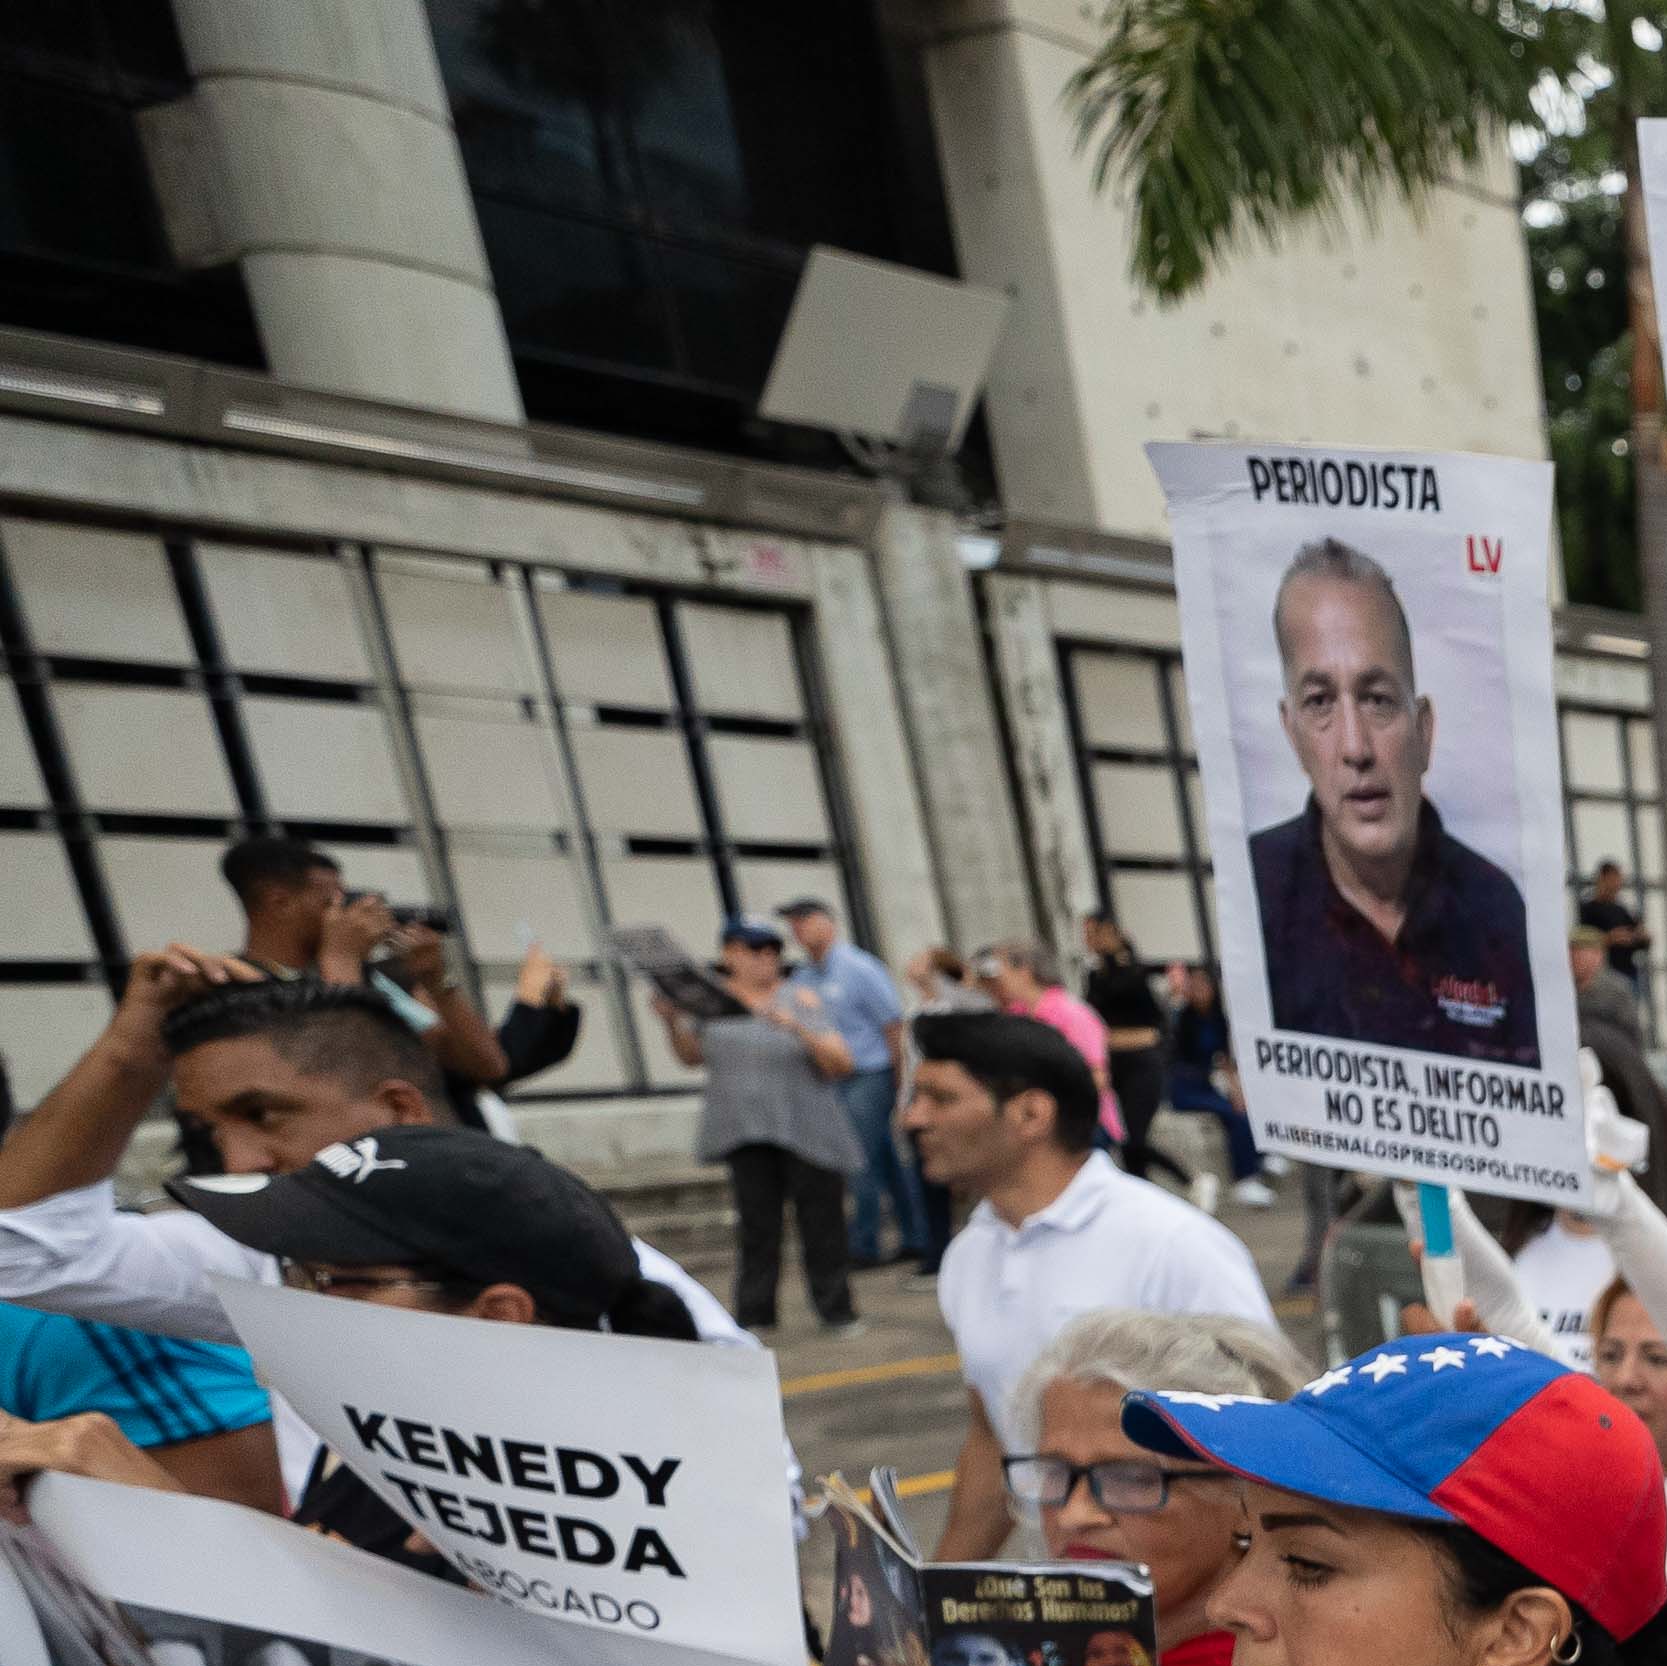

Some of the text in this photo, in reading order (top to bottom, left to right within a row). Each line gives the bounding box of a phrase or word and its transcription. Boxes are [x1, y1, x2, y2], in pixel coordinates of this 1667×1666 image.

[1248, 456, 1441, 513] PERIODISTA
[1466, 535, 1503, 577] LV
[1255, 1036, 1566, 1119] PERIODISTA, INFORMAR
[1263, 1119, 1582, 1193] #LIBERENALOSPRESOSPOLITICOS
[1325, 1089, 1501, 1149] NO ES DELITO
[342, 1404, 683, 1509] KENEDY
[380, 1470, 689, 1580] TEJEDA
